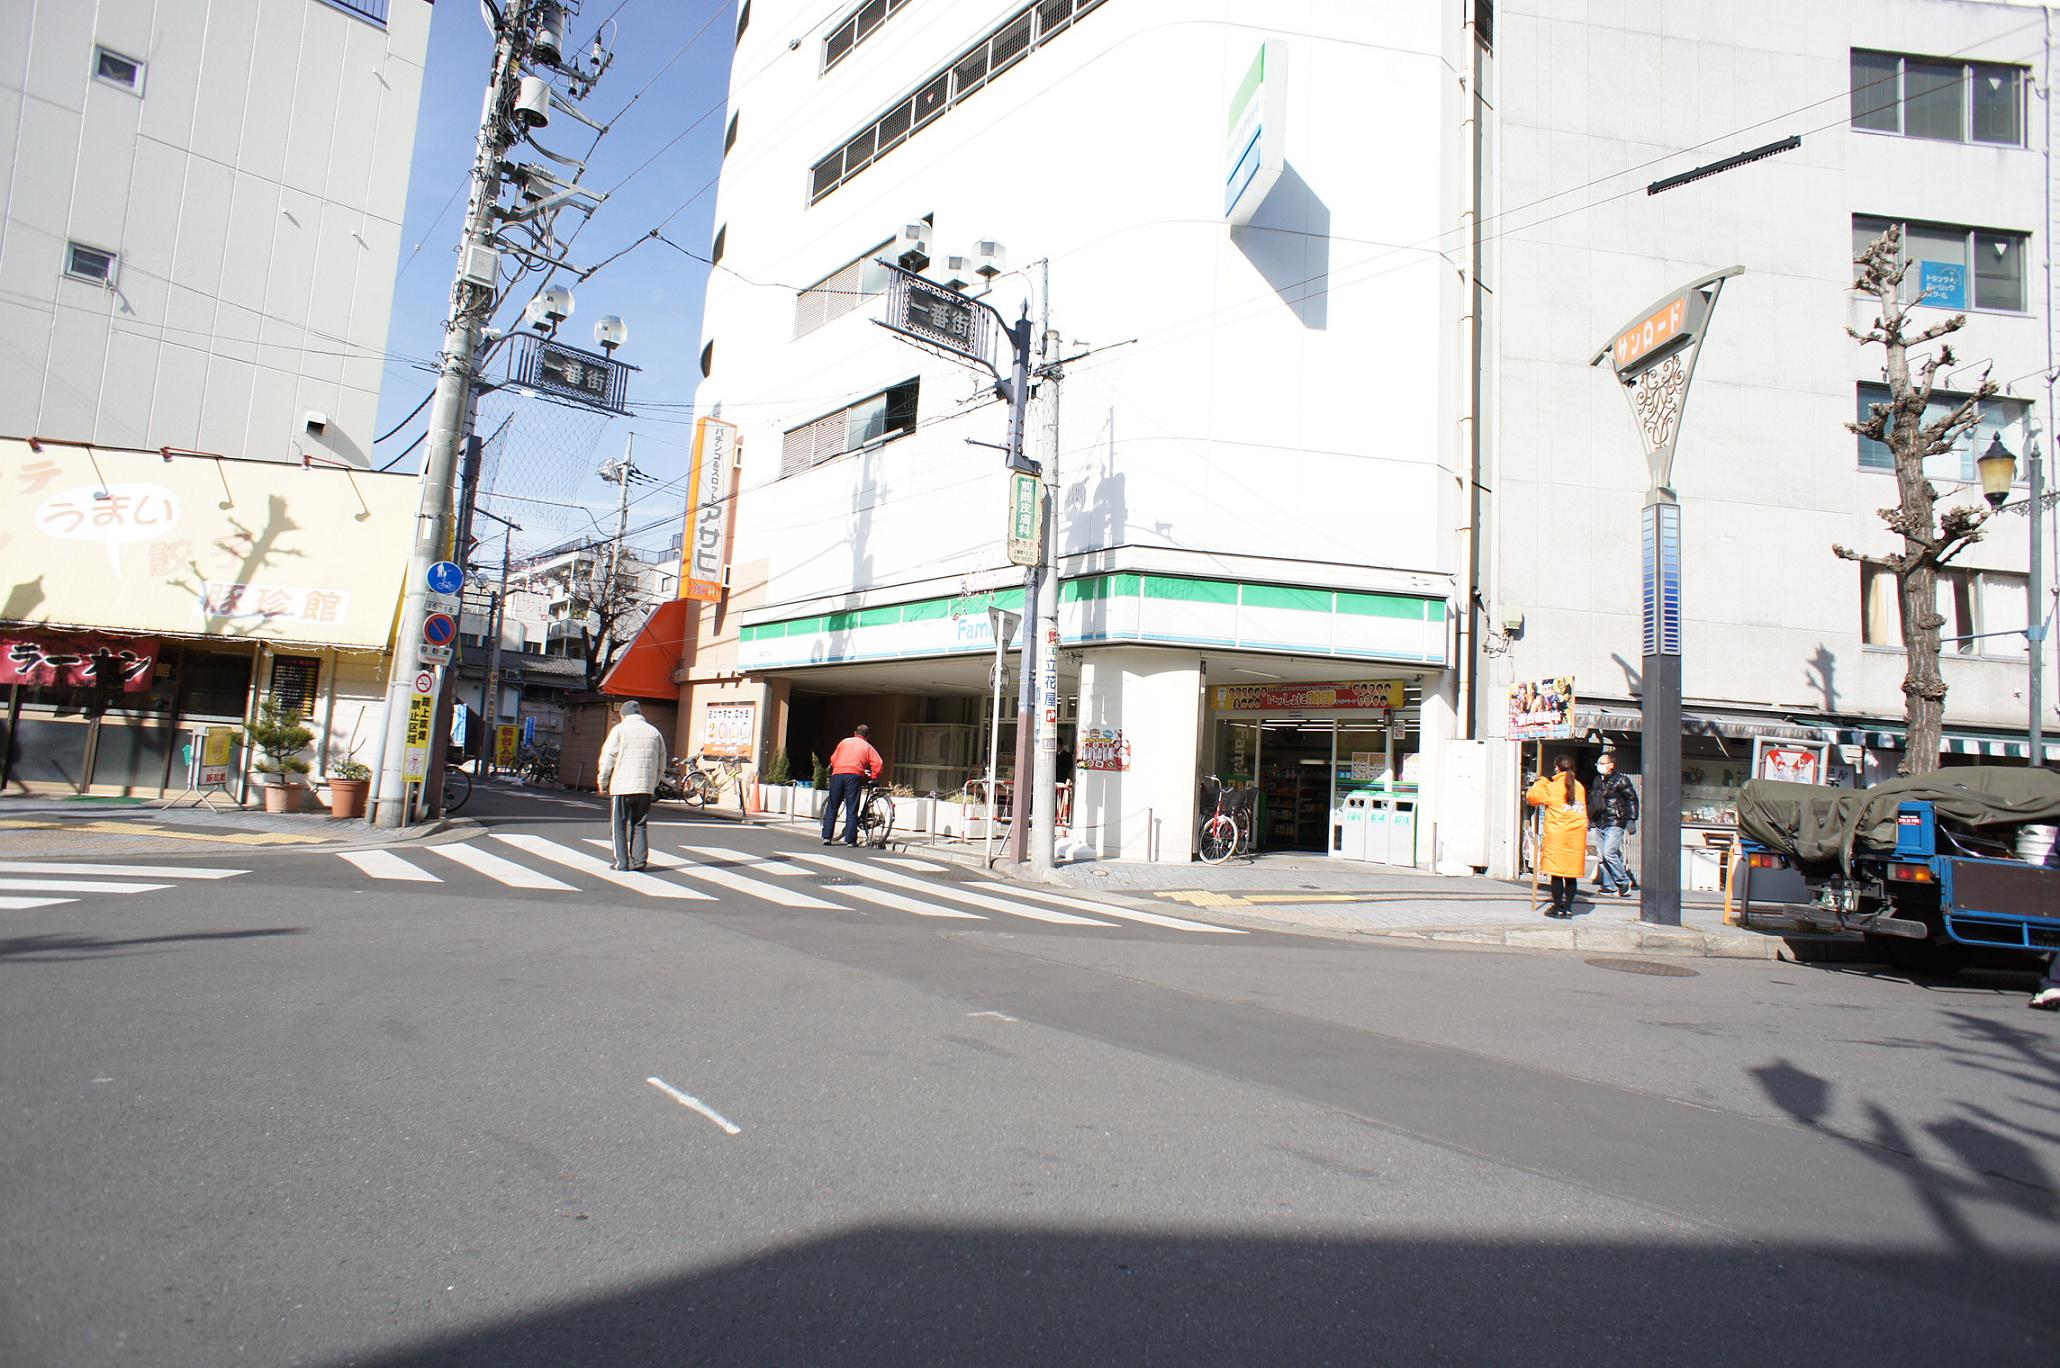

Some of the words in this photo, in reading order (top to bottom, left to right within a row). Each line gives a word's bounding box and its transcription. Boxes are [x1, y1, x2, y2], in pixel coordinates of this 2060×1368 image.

[910, 302, 972, 338] 一番街
[1617, 302, 1682, 361] サンロード
[544, 359, 605, 391] 一番街
[43, 495, 173, 533] うまい
[203, 583, 342, 622] 豚珍館
[1044, 658, 1057, 707] 立花屋
[406, 699, 421, 745] 禁止区域
[417, 696, 431, 741] 路上喫煙
